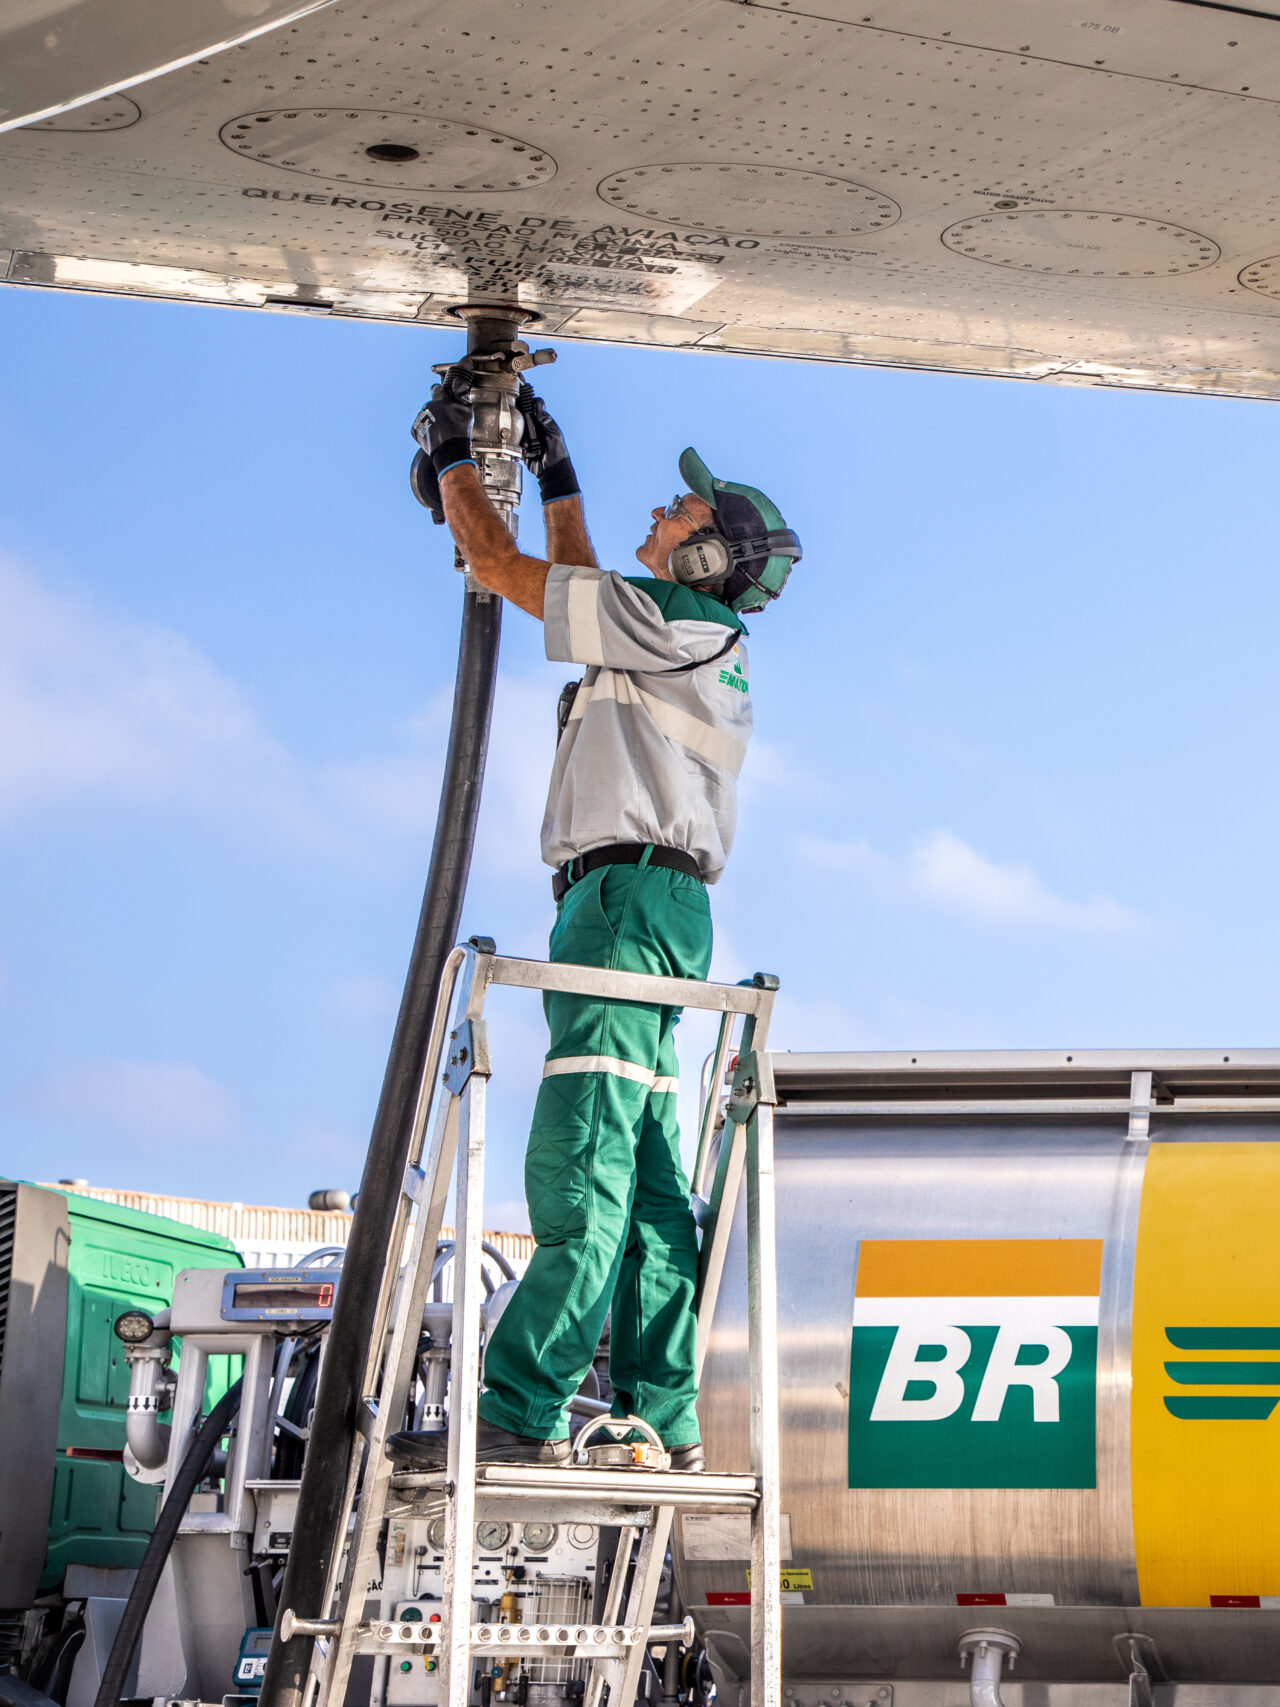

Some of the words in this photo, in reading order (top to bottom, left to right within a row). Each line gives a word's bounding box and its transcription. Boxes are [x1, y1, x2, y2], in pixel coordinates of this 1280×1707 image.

[1080, 21, 1101, 30] 675
[241, 187, 502, 223] QUEROSENE
[520, 217, 576, 231] DE
[592, 225, 761, 249] AVIAÇÃO
[381, 213, 537, 236] PRESSÃO
[434, 228, 470, 238] 50
[102, 1254, 151, 1287] IVECO
[869, 1325, 1073, 1423] BR
